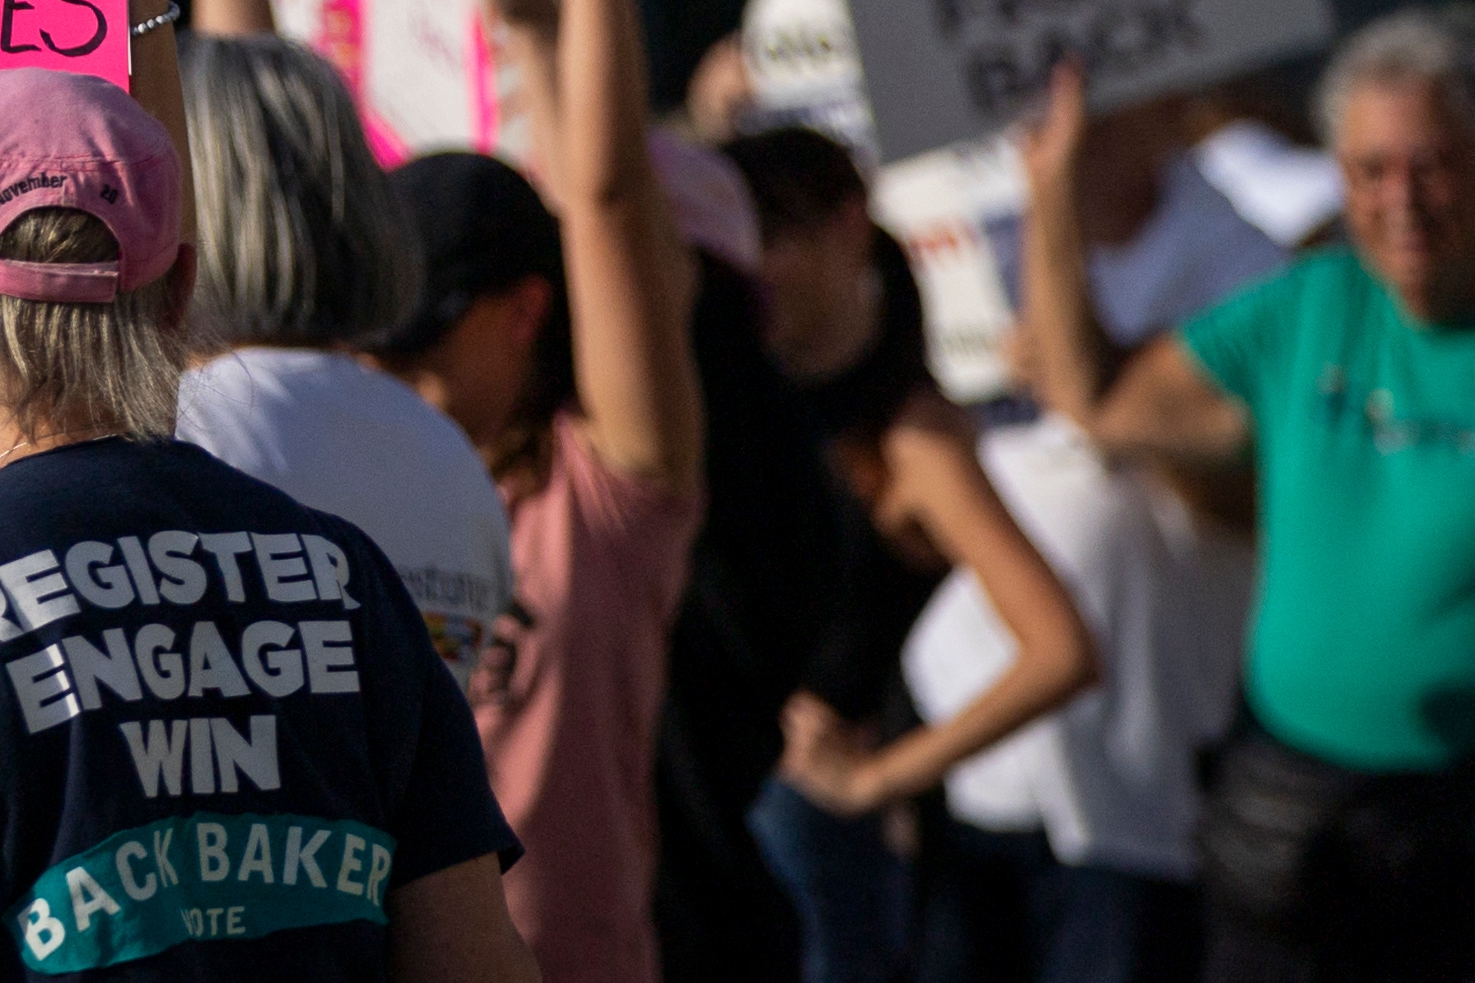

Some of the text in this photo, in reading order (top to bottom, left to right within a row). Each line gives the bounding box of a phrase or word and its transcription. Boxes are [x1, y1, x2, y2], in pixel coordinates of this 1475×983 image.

[6, 620, 360, 734] ENGAGE
[120, 715, 281, 797] WIN
[17, 821, 394, 961] BACK BAKER
